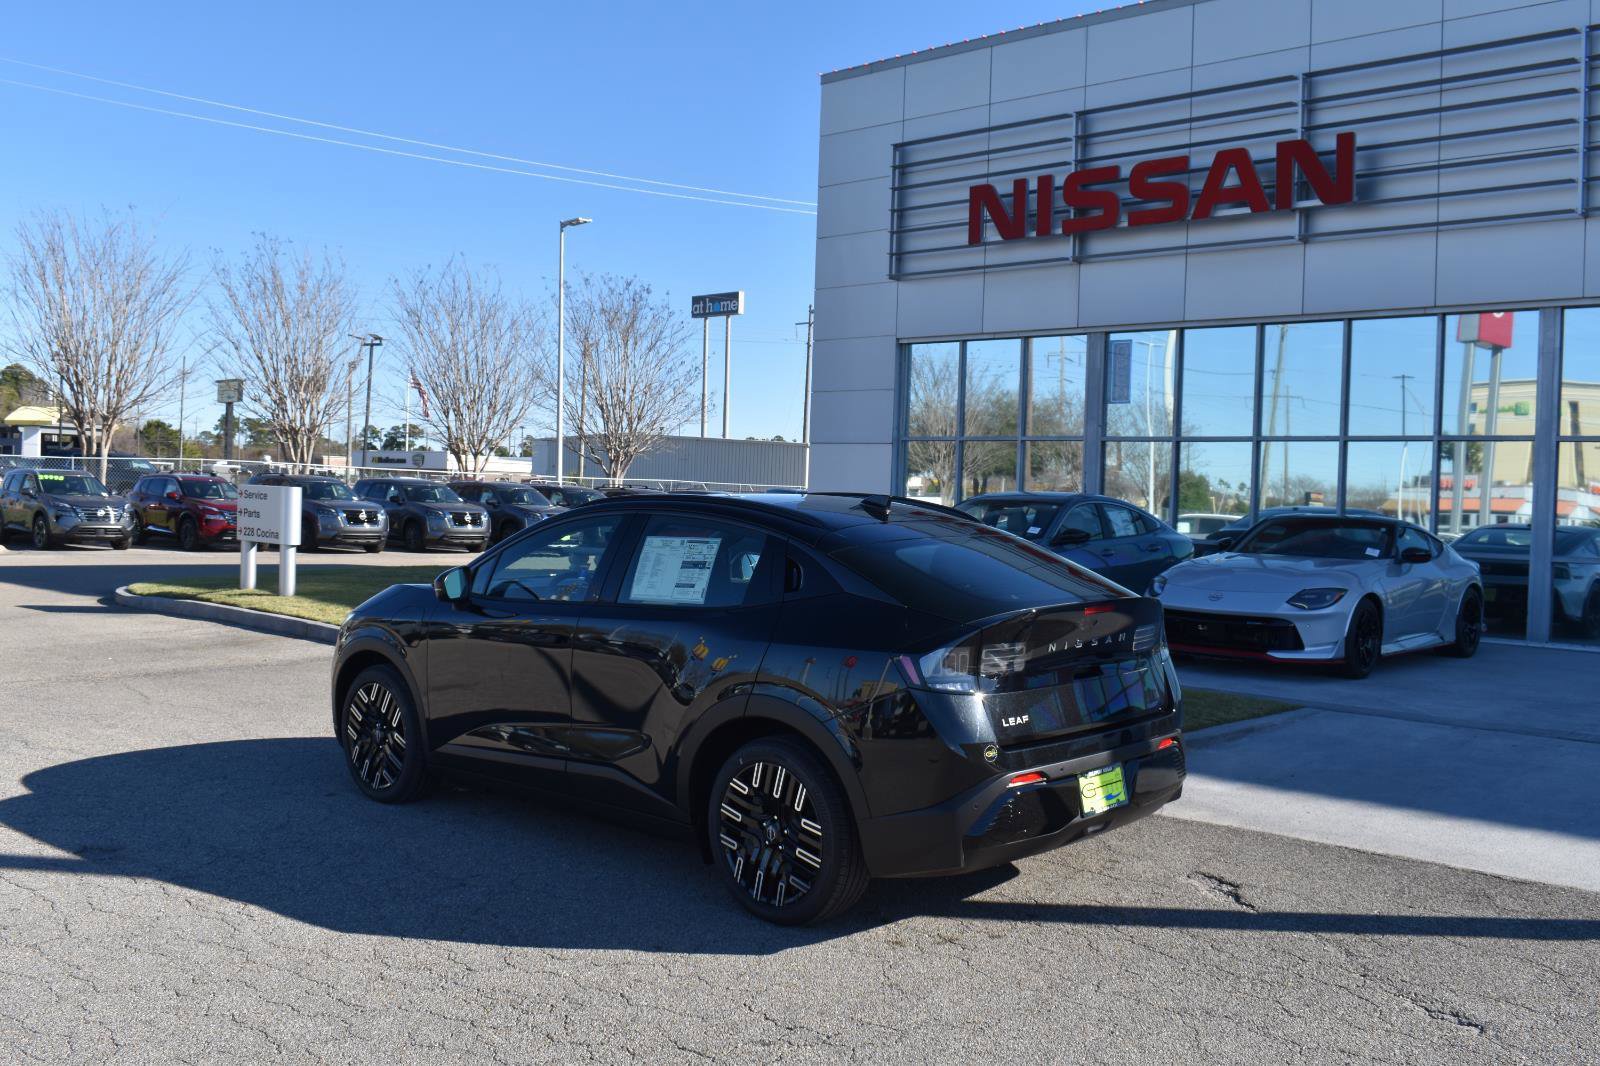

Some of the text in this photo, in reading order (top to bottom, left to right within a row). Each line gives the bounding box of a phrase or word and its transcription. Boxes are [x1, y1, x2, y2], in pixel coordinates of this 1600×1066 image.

[967, 131, 1356, 246] NISSAN
[692, 301, 704, 314] at
[243, 490, 268, 500] Service
[243, 508, 260, 518] Parts
[243, 527, 279, 539] 228 Cocina
[1048, 632, 1126, 652] NISSAN
[1001, 715, 1029, 727] LEAF
